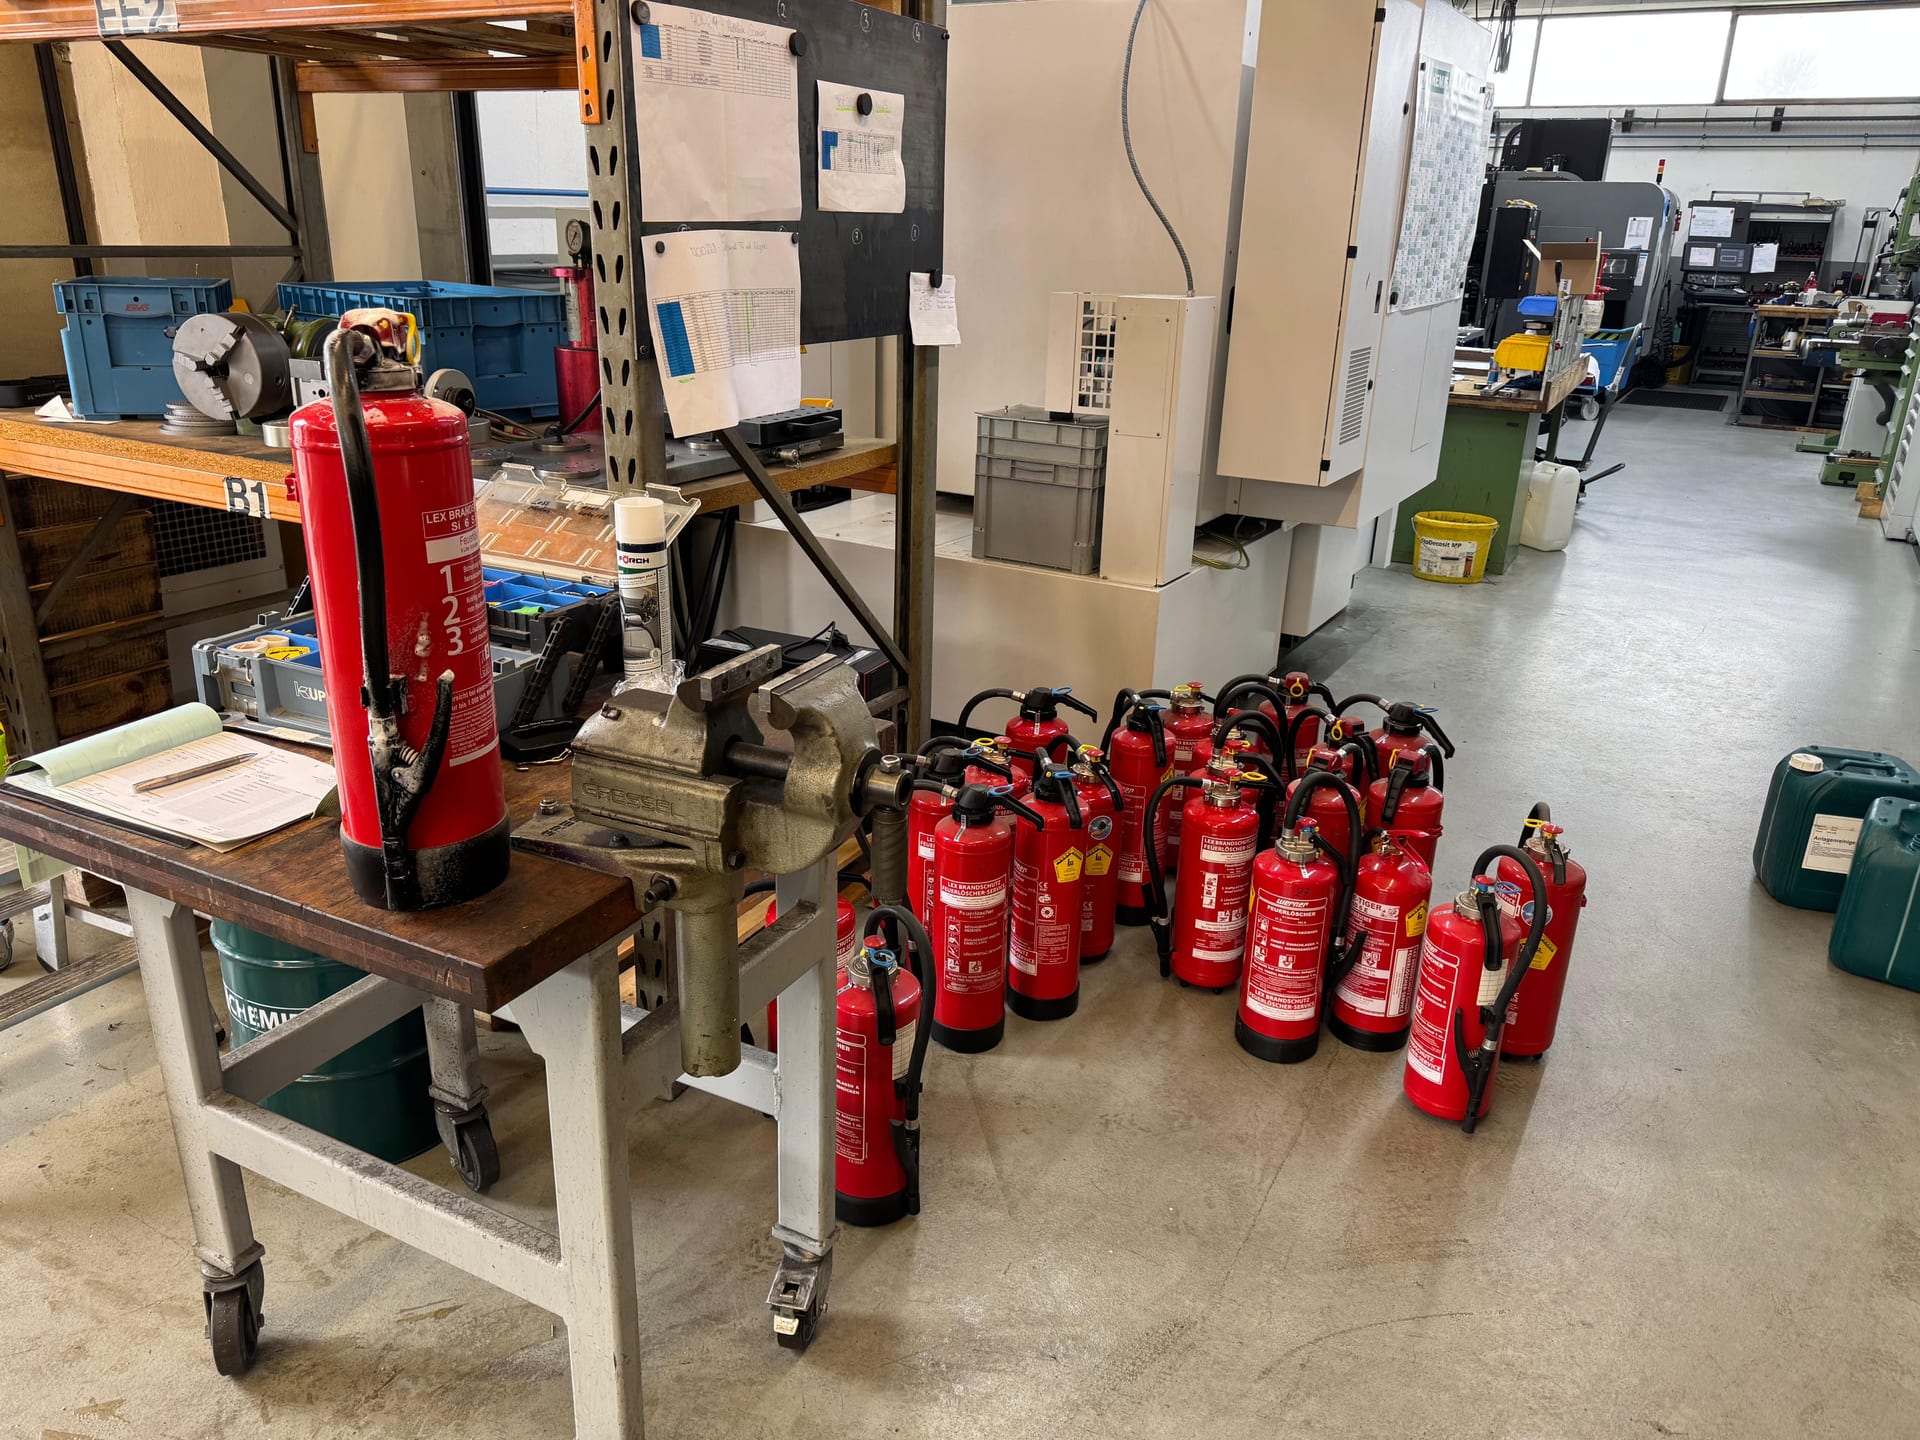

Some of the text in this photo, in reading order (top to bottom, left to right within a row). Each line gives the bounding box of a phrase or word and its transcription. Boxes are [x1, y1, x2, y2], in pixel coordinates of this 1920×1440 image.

[225, 476, 266, 518] B1
[426, 512, 447, 524] LEX
[440, 564, 453, 594] 1
[442, 595, 461, 626] 2
[446, 626, 464, 656] 3
[582, 782, 687, 821] GRESSEL
[1204, 837, 1214, 845] LEX
[947, 880, 1001, 891] LEX BRANDSCHUTZ
[1266, 904, 1317, 918] FEUERLÖSCHER
[1276, 898, 1310, 909] werner
[1254, 988, 1311, 1005] LEX BRANDSCHUTZ
